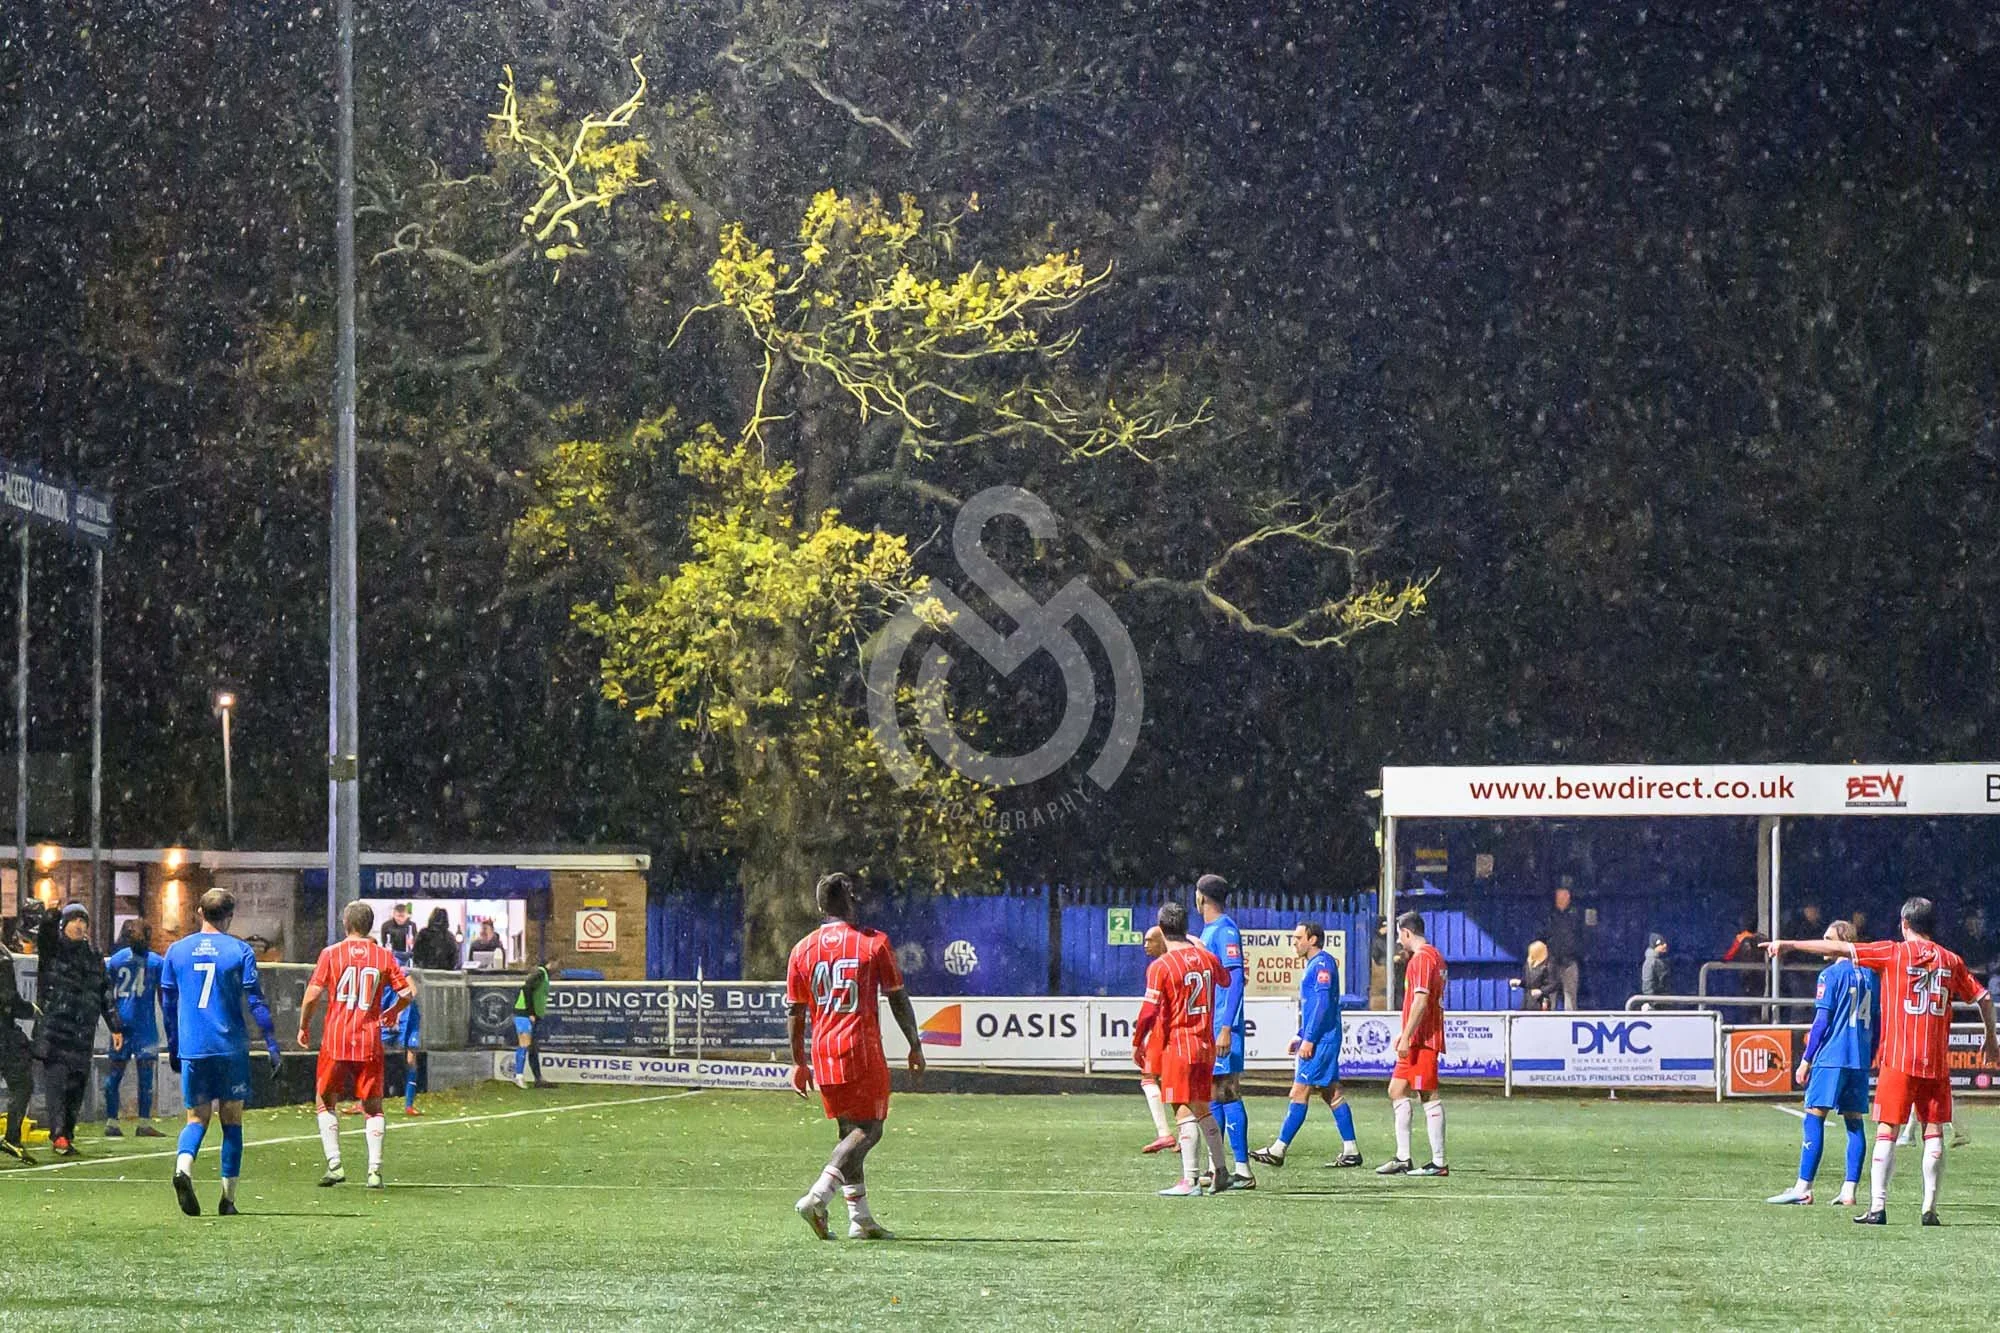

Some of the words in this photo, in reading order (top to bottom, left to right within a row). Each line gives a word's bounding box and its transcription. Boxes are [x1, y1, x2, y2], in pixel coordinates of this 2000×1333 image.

[1470, 775, 1794, 800] www.bewdirect.co.uk
[1846, 768, 1904, 802] BEW
[375, 871, 415, 889] FOOD
[419, 871, 469, 889] COURT
[1114, 917, 1125, 931] 2
[1326, 935, 1341, 947] FC
[118, 966, 145, 998] 24
[193, 962, 216, 1009] 7
[336, 966, 380, 1011] 40
[811, 958, 859, 1014] 45
[1184, 969, 1211, 1015] 21
[1256, 971, 1291, 984] CLUB
[1903, 966, 1951, 1017] 35
[546, 991, 714, 1008] EDDINGTONS
[1848, 986, 1872, 1030] 14
[976, 1013, 1077, 1039] OASIS
[1572, 1021, 1653, 1055] DMC
[542, 1056, 633, 1071] DVERTISE
[639, 1061, 690, 1073] YOUR
[696, 1063, 790, 1078] COMPANY
[1529, 1074, 1588, 1082] SPECIALISTS
[1589, 1073, 1631, 1082] FINISHES
[1633, 1073, 1697, 1082] CONTRACTOR
